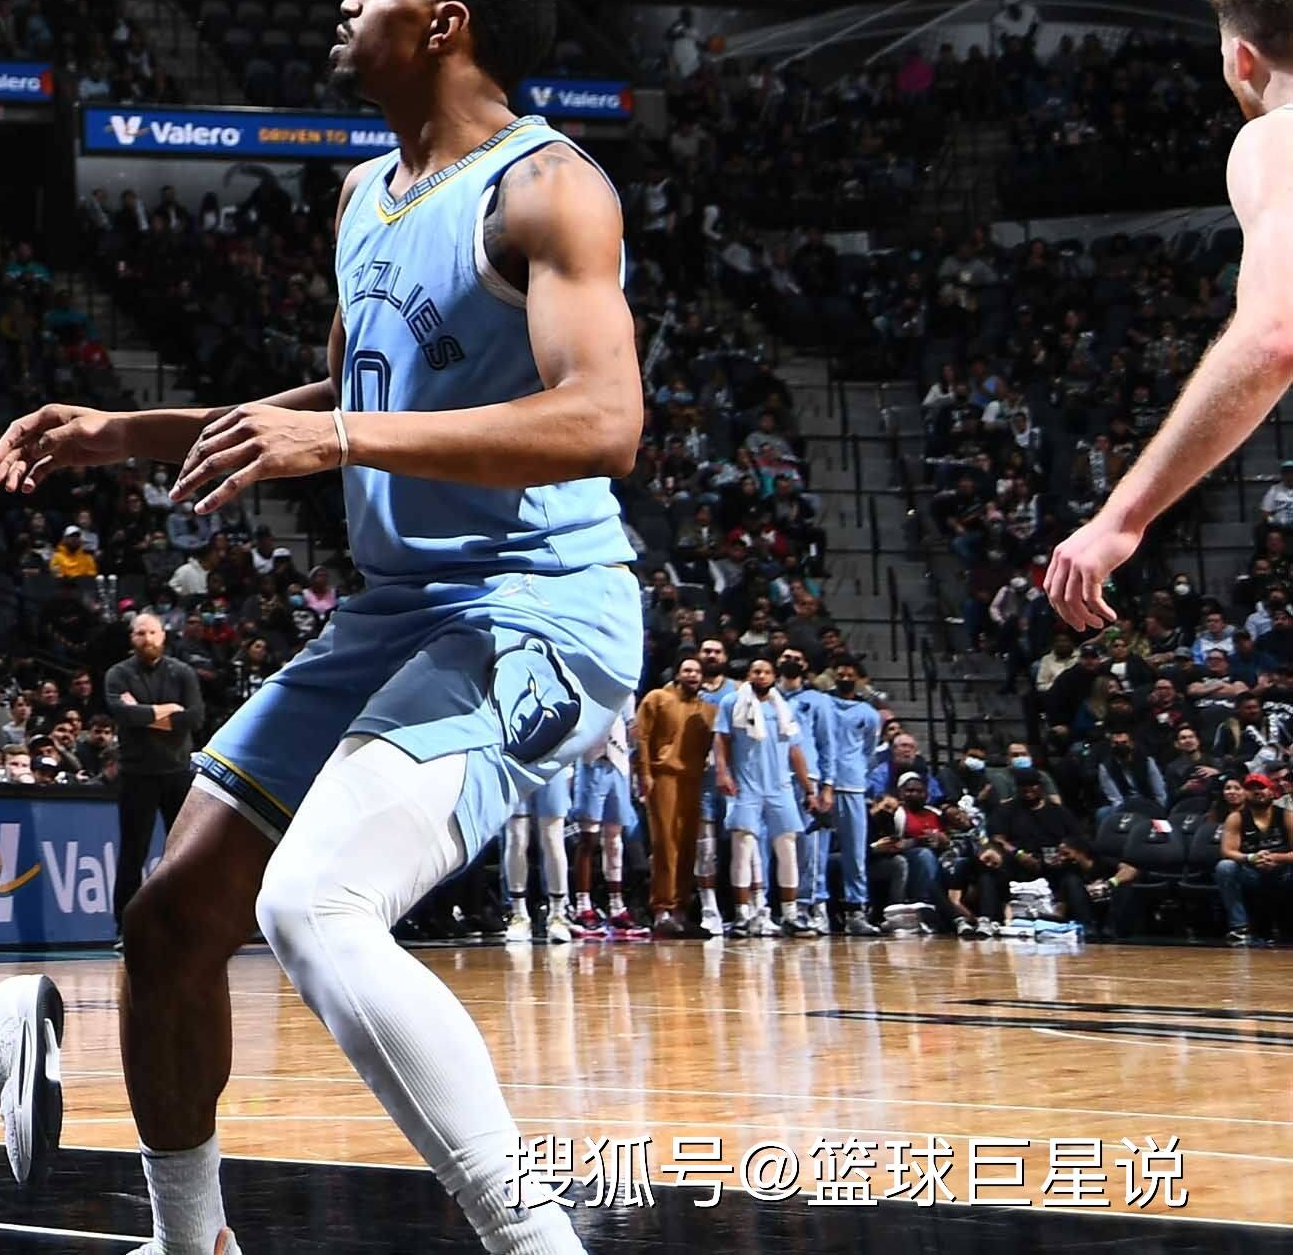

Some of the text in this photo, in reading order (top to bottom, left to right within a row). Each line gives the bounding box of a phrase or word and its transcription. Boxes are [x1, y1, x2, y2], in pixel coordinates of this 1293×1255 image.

[557, 89, 621, 110] Valero
[150, 121, 242, 146] Valero
[258, 127, 321, 144] DRIVEN
[325, 128, 348, 144] TO
